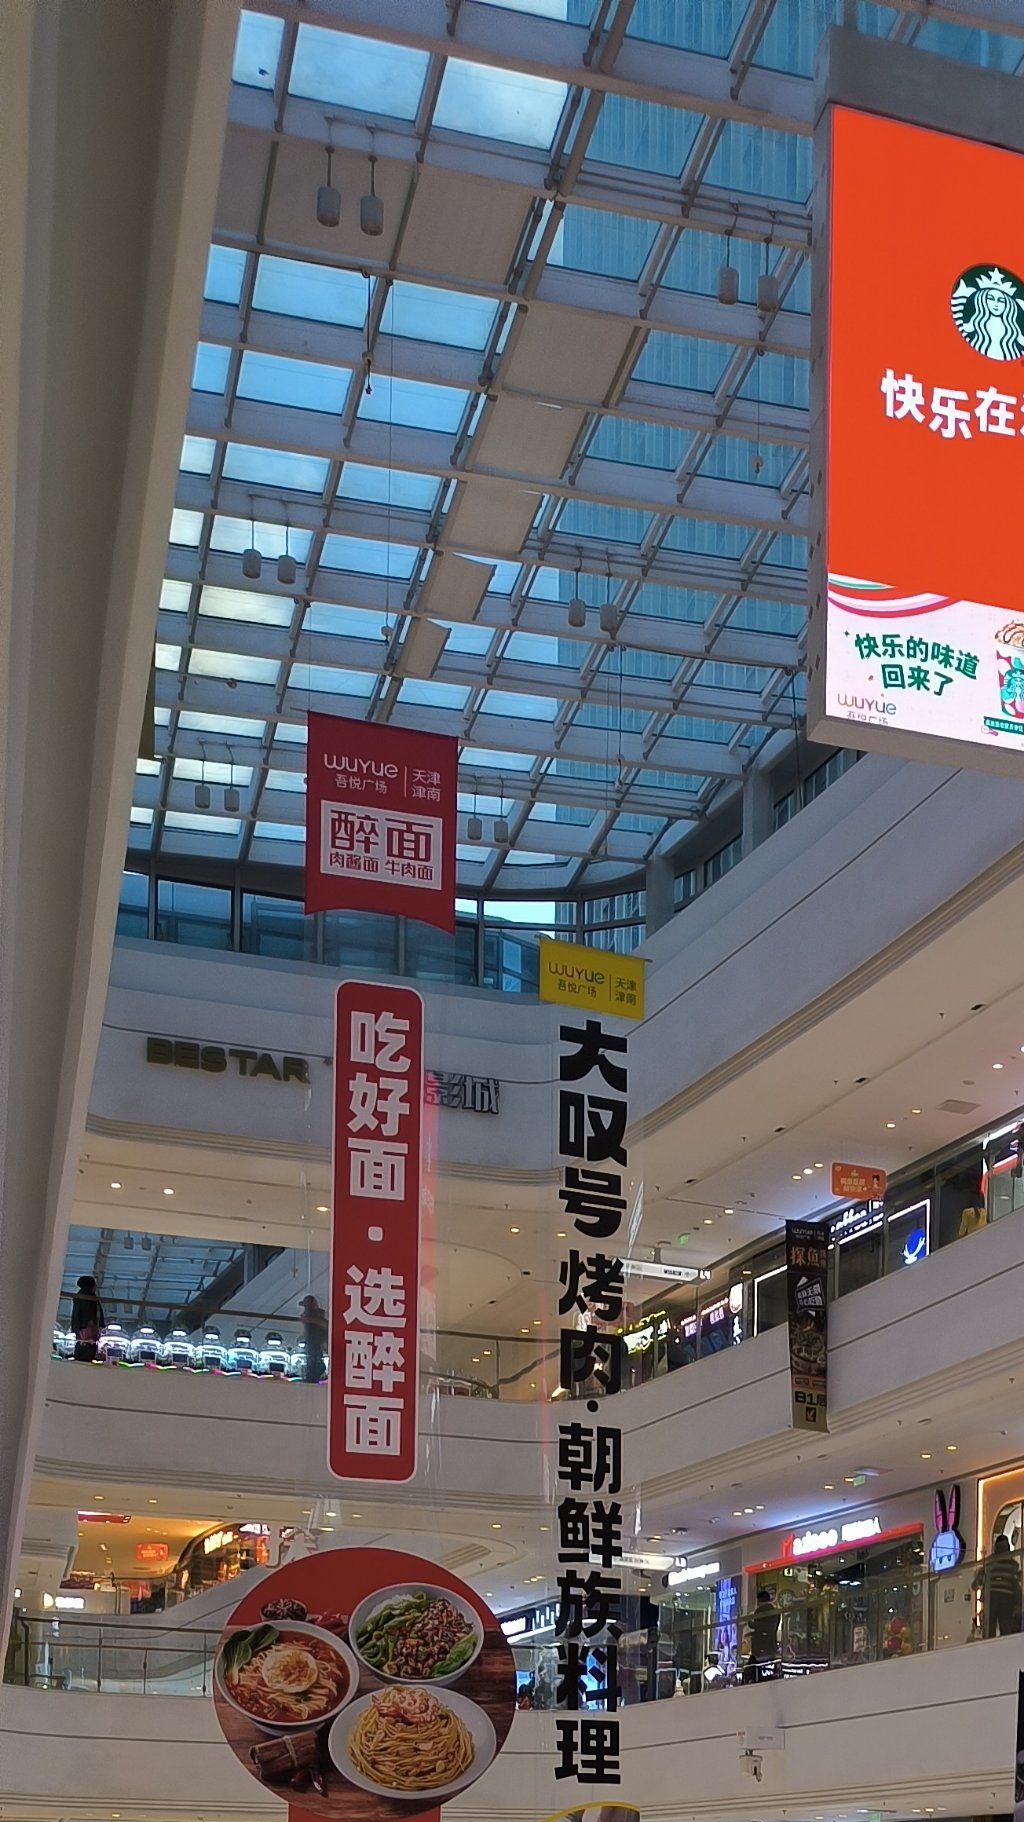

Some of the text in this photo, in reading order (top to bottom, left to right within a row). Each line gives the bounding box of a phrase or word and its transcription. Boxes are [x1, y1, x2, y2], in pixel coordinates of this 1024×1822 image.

[854, 633, 980, 680] 快乐的味道
[881, 663, 954, 696] 回来了
[335, 773, 388, 795] 吾悦广场
[412, 769, 441, 786] 天津
[412, 785, 441, 802] 津南
[330, 809, 434, 863] 醉面
[329, 851, 433, 881] 肉酱面 牛肉面
[558, 979, 597, 998] 吾悦广场
[615, 977, 637, 991] 天津
[146, 1037, 310, 1084] BESTAR
